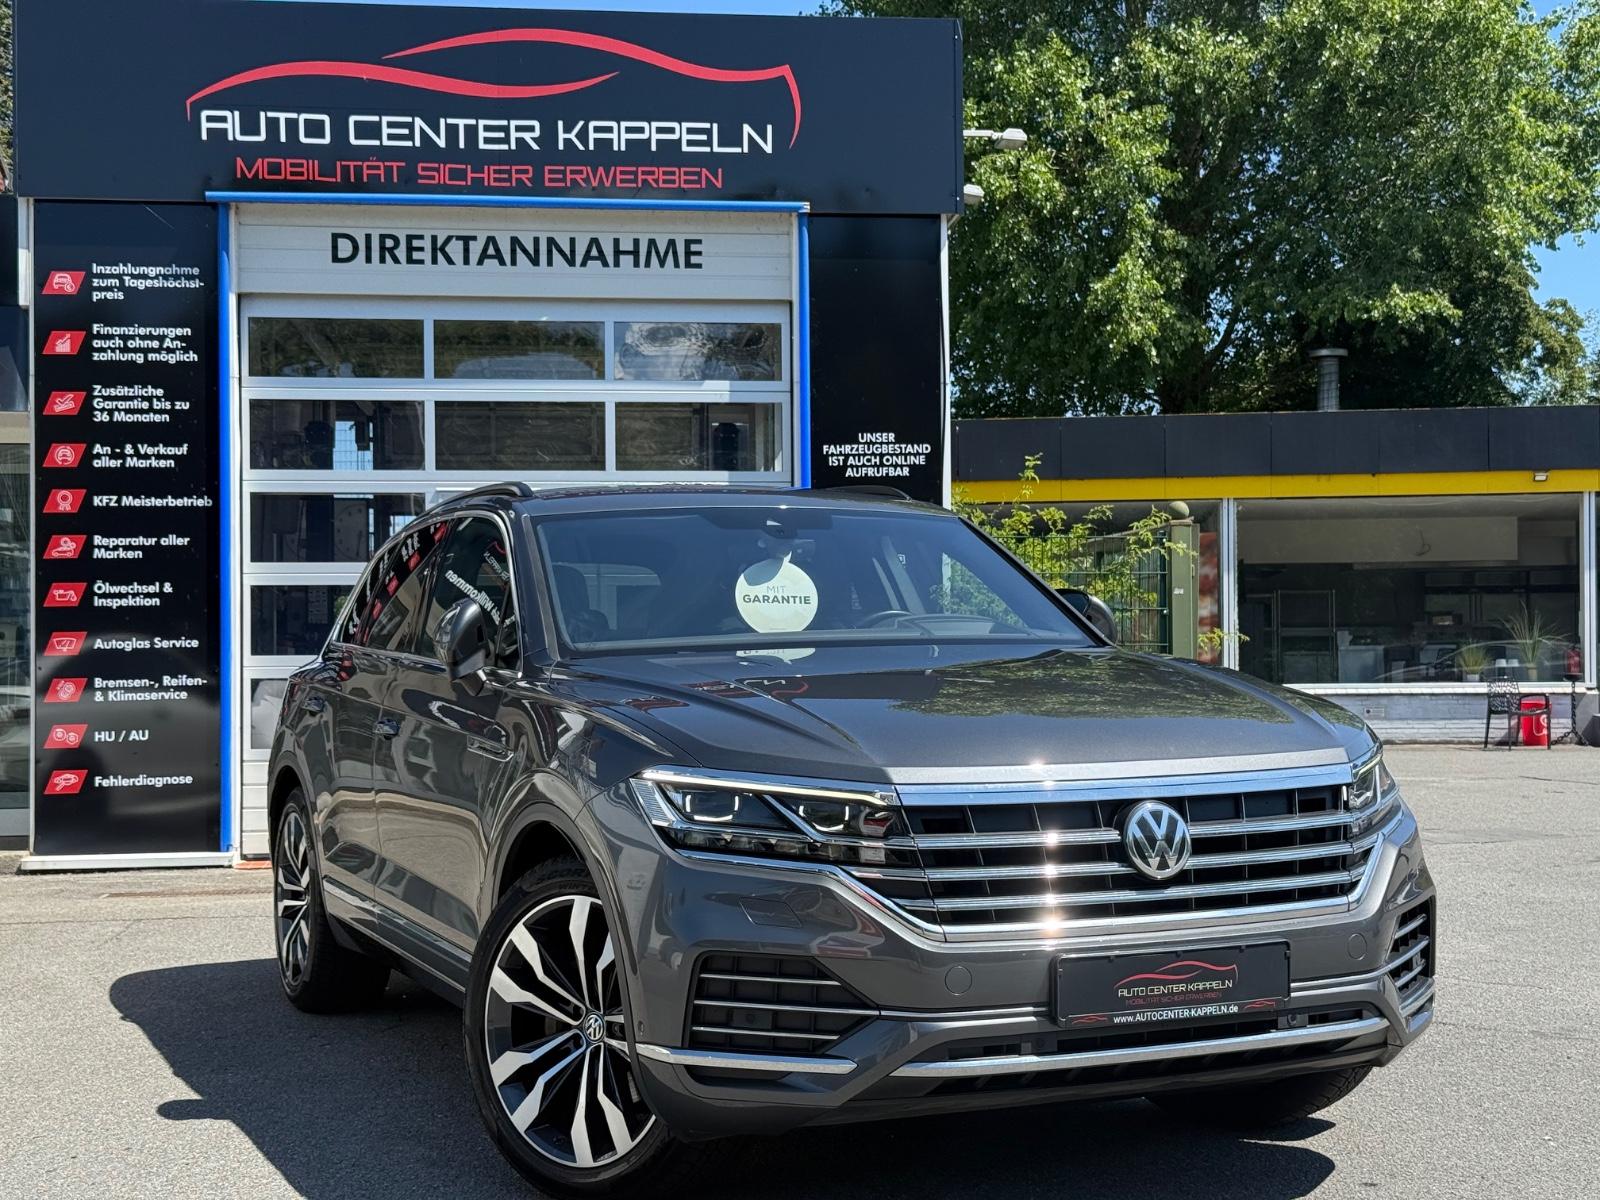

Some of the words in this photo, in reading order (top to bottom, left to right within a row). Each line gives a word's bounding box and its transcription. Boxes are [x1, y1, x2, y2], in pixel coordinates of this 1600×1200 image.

[201, 110, 330, 144] AUTO
[349, 115, 540, 150] CENTER
[558, 120, 772, 153] KAPPELN
[236, 157, 404, 182] MOBILITÄT
[417, 162, 533, 187] SICHER
[544, 165, 722, 188] ERWERBEN
[331, 233, 702, 269] DIREKTANNAHME
[92, 262, 200, 277] Inzahlungnahme
[92, 278, 120, 287] zum
[122, 275, 205, 290] Tageshöchst-
[92, 288, 125, 303] preis
[92, 323, 192, 339] Finanzierungen
[92, 336, 124, 348] auch
[126, 336, 160, 349] ohne
[162, 335, 187, 349] An-
[91, 349, 145, 364] zahlung
[147, 349, 199, 365] möglich
[92, 384, 165, 397] Zusätzliche
[92, 397, 150, 410] Garantie
[152, 397, 172, 410] bis
[174, 401, 190, 410] zu
[92, 410, 110, 423] 36
[112, 410, 170, 423] Monaten
[858, 432, 896, 443] UNSER
[92, 443, 112, 455] An
[124, 443, 135, 455] &
[137, 443, 189, 456] Verkauf
[822, 443, 932, 455] FAHRZEUGBESTAND
[92, 455, 124, 468] aller
[125, 455, 175, 468] Marken
[828, 455, 845, 467] IST
[846, 455, 880, 466] AUCH
[882, 454, 926, 466] ONLINE
[845, 466, 910, 478] AUFRUFBAR
[93, 495, 119, 507] KFZ
[120, 494, 213, 507] Meisterbetrieb
[93, 534, 158, 550] Reparatur
[159, 534, 191, 546] aller
[92, 546, 143, 559] Marken
[93, 579, 160, 594] Ölwechsel
[162, 581, 174, 594] &
[766, 585, 786, 594] MIT
[93, 594, 161, 610] Inspektion
[742, 594, 812, 605] GARANTIE
[93, 637, 151, 652] Autoglas
[153, 636, 200, 649] Service
[94, 677, 160, 689] Bremsen-,
[162, 674, 208, 687] Reifen-
[93, 690, 105, 702] &
[107, 688, 188, 702] Klimaservice
[94, 730, 116, 742] HU
[118, 730, 127, 743] /
[128, 729, 149, 742] AU
[94, 773, 194, 788] Fehlerdiagnose
[1118, 987, 1146, 997] AUTO
[1148, 983, 1186, 995] CENTER
[1187, 980, 1233, 991] KAPPELN
[1113, 1004, 1239, 1023] www.AUTOCENTER-KAPPELN.de
